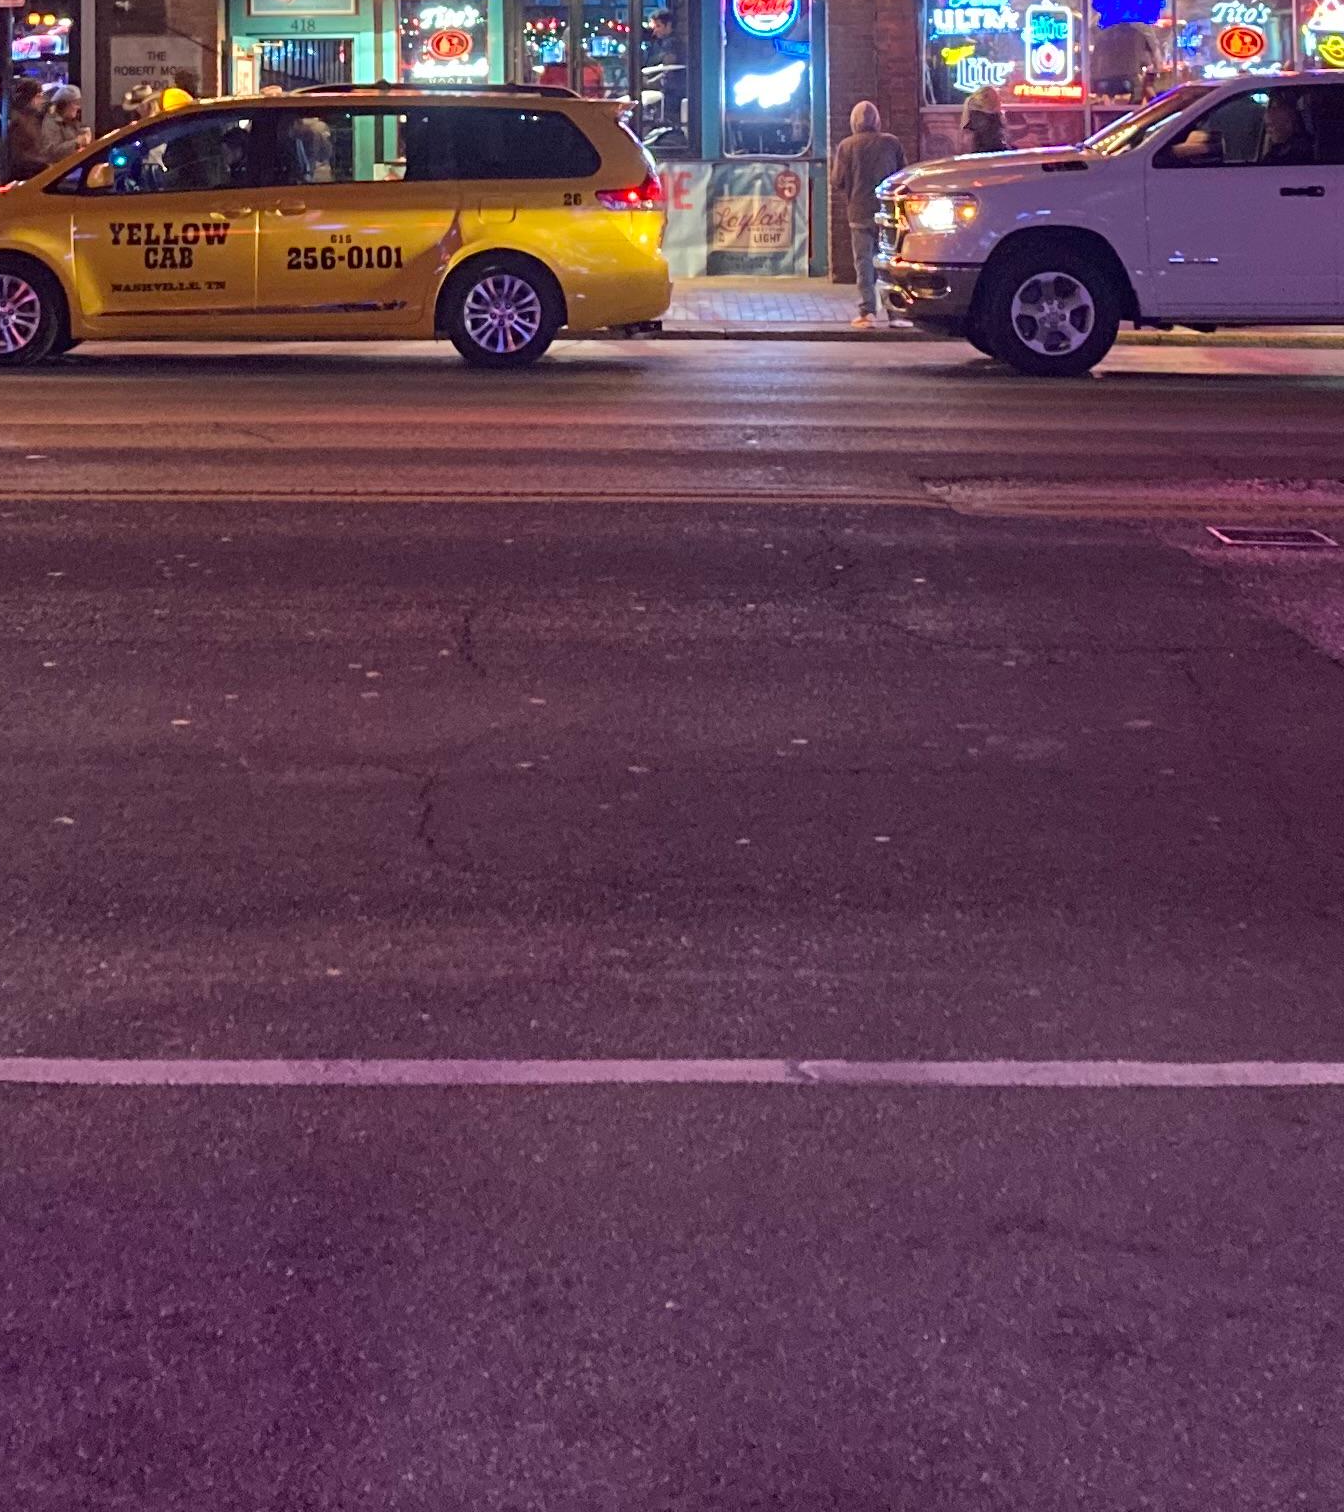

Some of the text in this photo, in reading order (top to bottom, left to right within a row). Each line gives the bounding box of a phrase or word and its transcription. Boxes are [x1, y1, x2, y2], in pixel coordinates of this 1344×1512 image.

[1210, 0, 1272, 24] Tito's
[290, 18, 316, 33] 418
[147, 50, 167, 62] THE
[113, 65, 156, 77] ROBERT
[563, 192, 583, 206] 26
[109, 222, 231, 246] YELLOW
[753, 233, 782, 244] LIGHT
[143, 246, 194, 270] CAB
[286, 246, 404, 271] 256-0101
